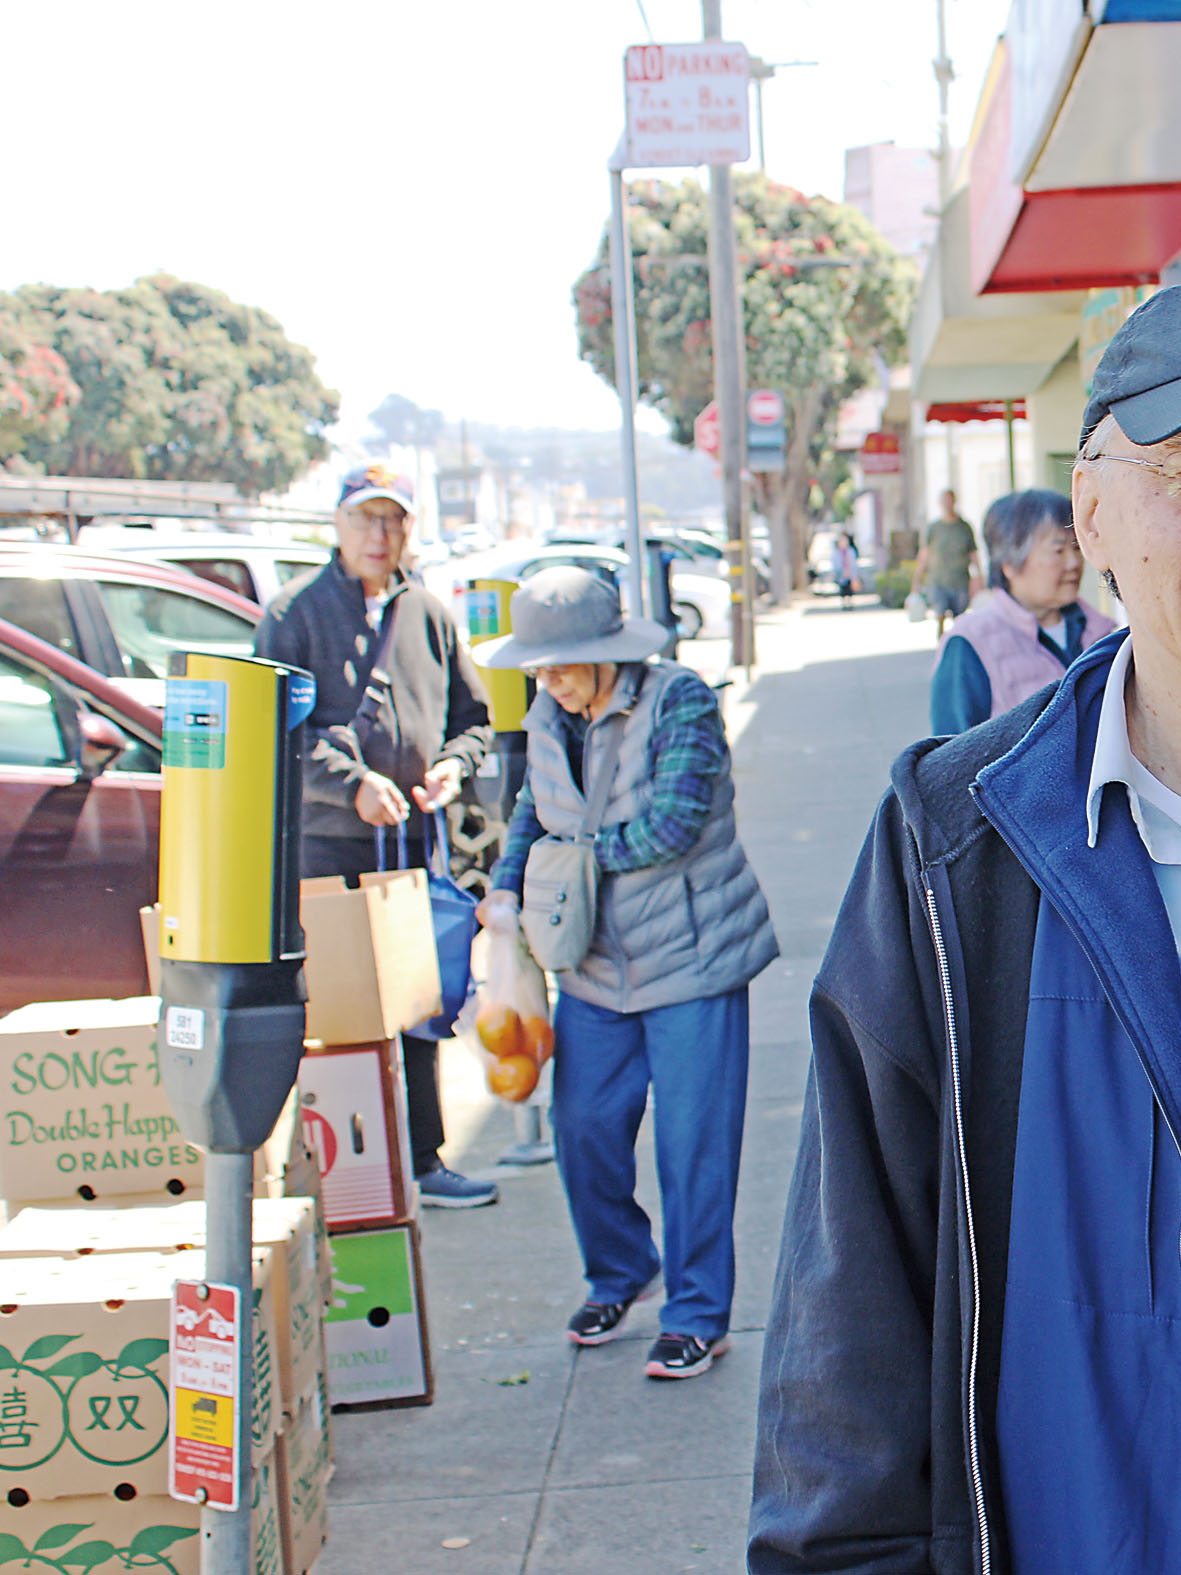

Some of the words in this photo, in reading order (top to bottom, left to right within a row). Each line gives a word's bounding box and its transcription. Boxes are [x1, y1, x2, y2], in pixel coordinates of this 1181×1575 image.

[626, 46, 663, 81] NO
[668, 54, 746, 76] PARKING
[637, 116, 674, 134] MON
[698, 112, 741, 132] THUR
[11, 1047, 138, 1095] SONG
[5, 1108, 101, 1146] Double
[56, 1145, 199, 1174] ORANGES
[328, 1349, 390, 1371] TIONAL
